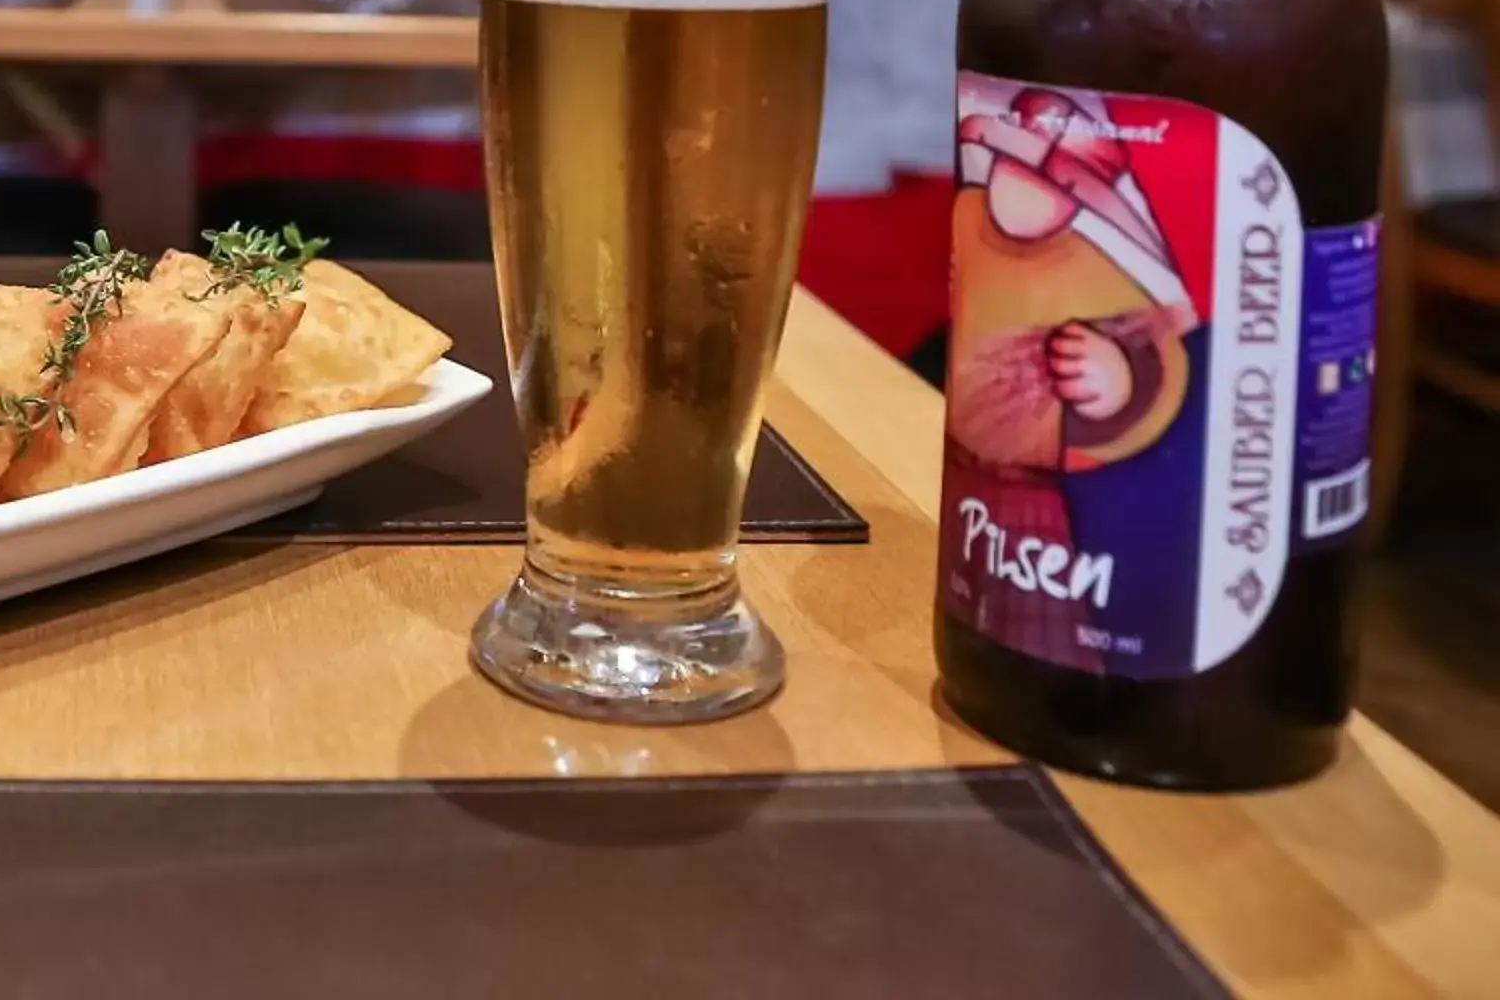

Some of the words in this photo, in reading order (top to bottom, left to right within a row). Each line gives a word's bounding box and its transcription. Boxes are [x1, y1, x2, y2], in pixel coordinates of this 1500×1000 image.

[1238, 224, 1282, 343] BEER
[1226, 365, 1276, 554] SAUBER
[959, 498, 1114, 609] Pilsen
